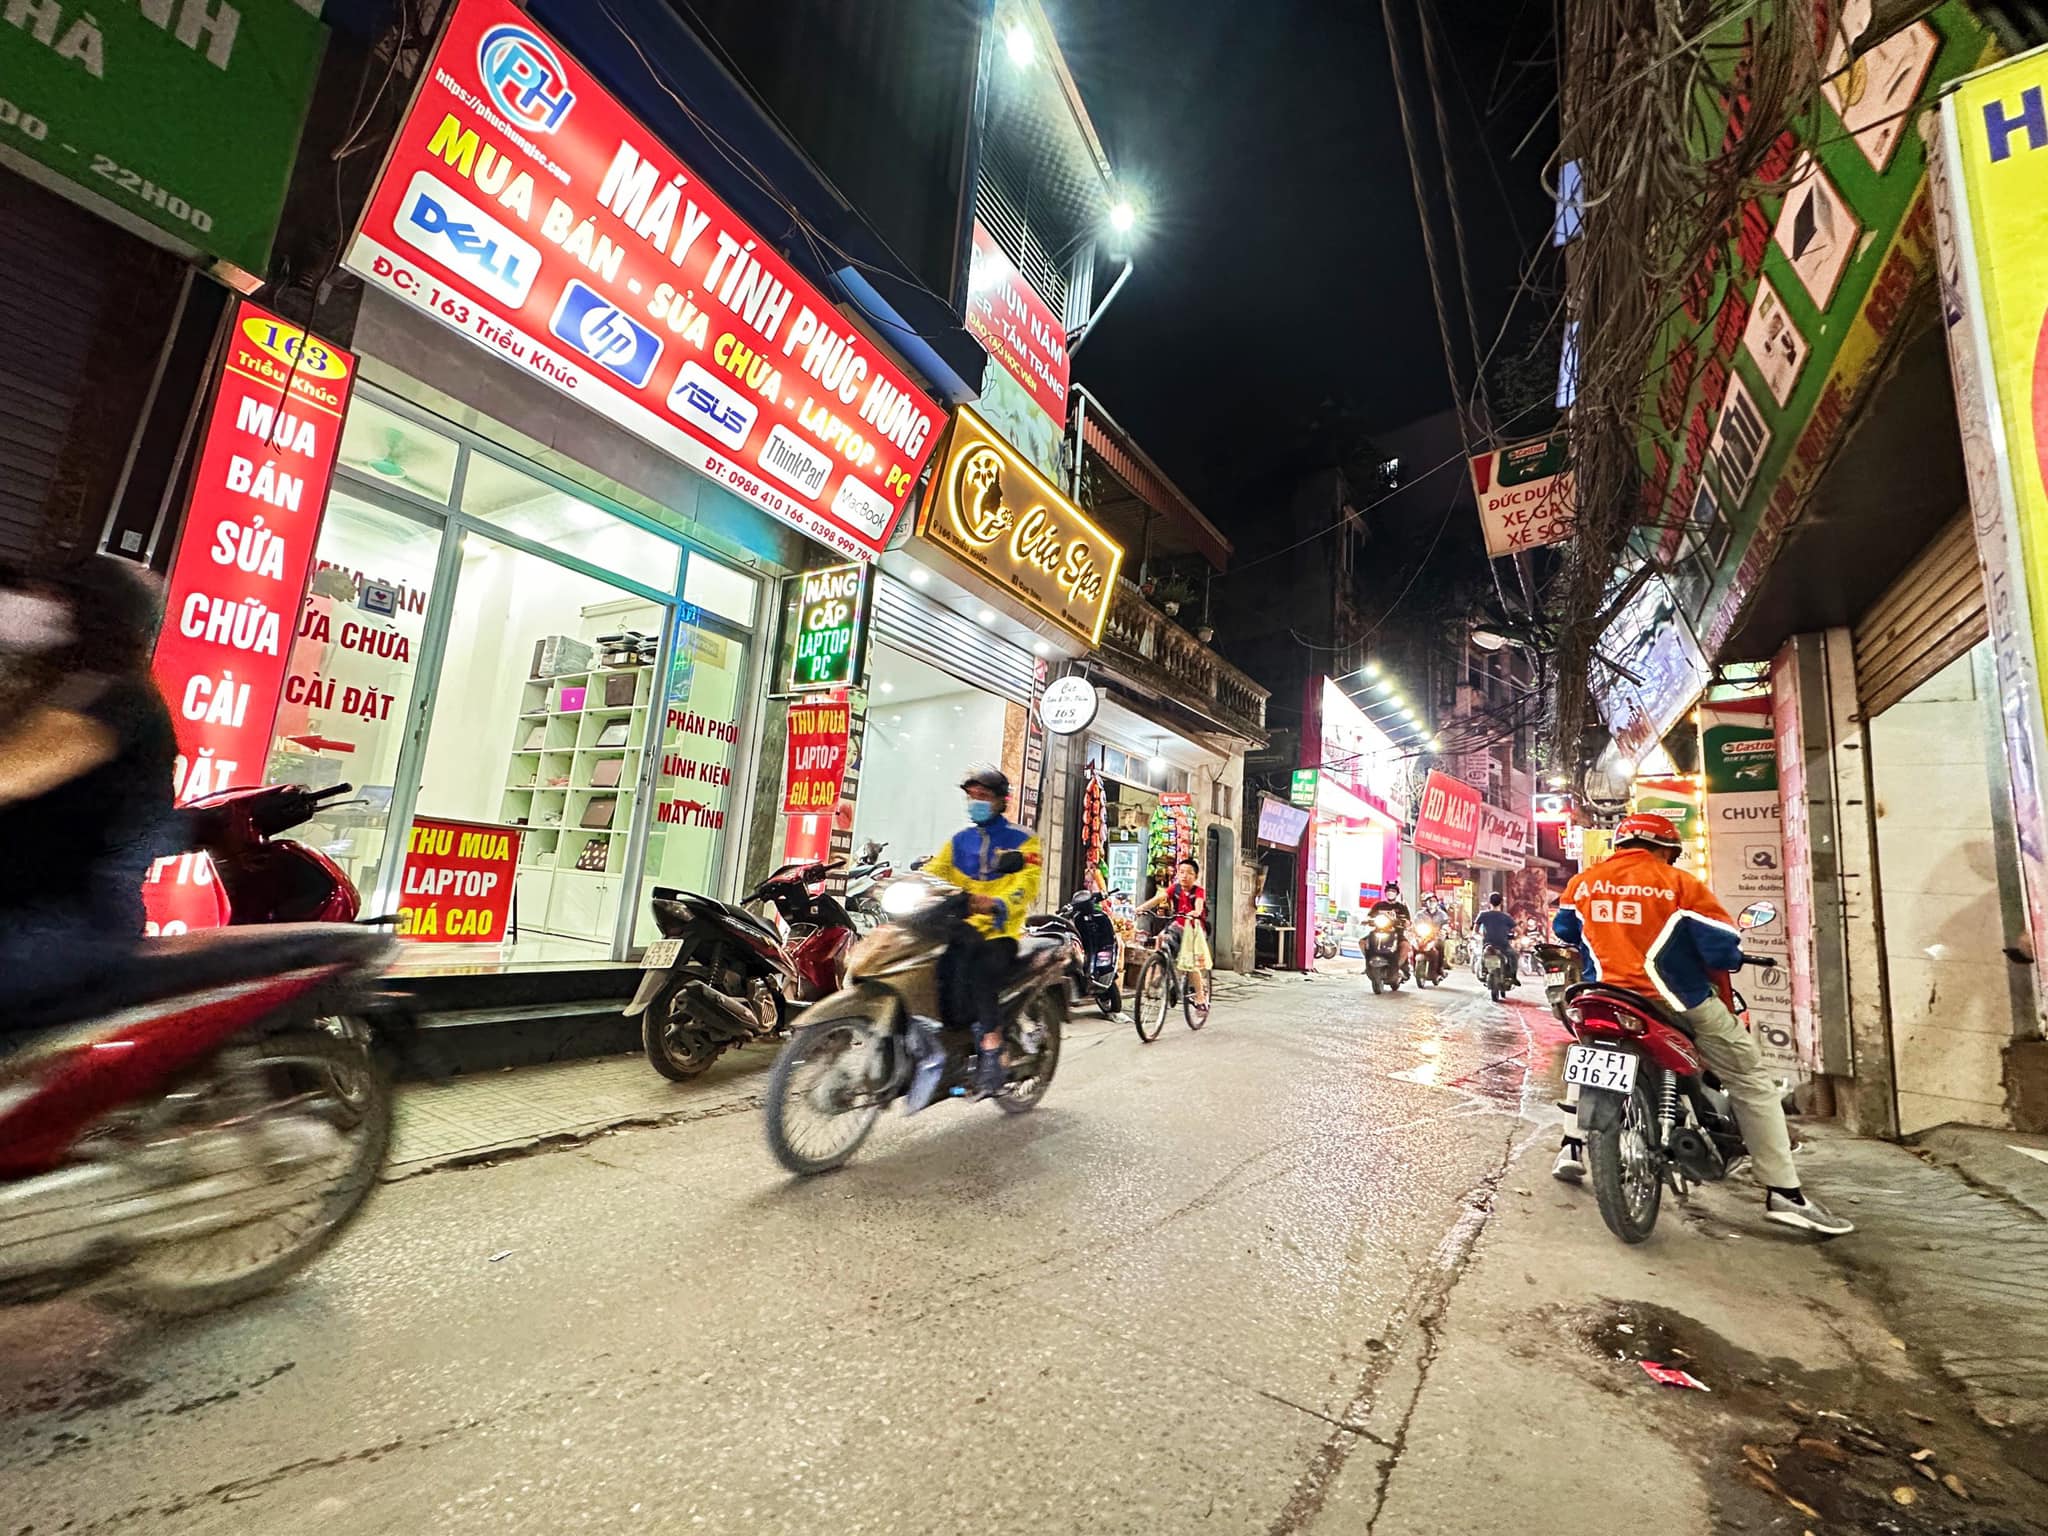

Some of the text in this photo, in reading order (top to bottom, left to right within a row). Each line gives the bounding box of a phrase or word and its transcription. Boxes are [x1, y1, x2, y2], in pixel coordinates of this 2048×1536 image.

[89, 153, 213, 233] 22H00
[409, 191, 521, 290] DELL
[426, 112, 536, 223] MUA
[539, 196, 627, 285] BÁN
[645, 281, 712, 352] SỬA
[796, 396, 878, 468] LAPTOP
[883, 463, 911, 500] PC
[596, 138, 932, 461] MÁY TÍNH PHÚC HƯNG
[372, 256, 579, 389] ĐC: 163 Triều Khúc
[585, 304, 634, 367] hp
[260, 324, 329, 372] 163
[1003, 349, 1021, 375] HỌC
[290, 372, 338, 406] Khúc
[675, 380, 748, 436] ASUS
[235, 395, 317, 459] MUA
[766, 433, 827, 491] ThinkPad
[225, 453, 304, 512] BÁN
[704, 456, 727, 478] ĐT:
[728, 471, 758, 496] 0988
[760, 491, 782, 510] 410
[785, 503, 804, 524] 166
[810, 520, 835, 542] 0398
[837, 536, 856, 554] 999
[840, 487, 887, 530] MacBook
[1487, 493, 1522, 512] ĐỨC
[1501, 501, 1563, 529] XE GA
[209, 515, 286, 582] SỬA
[1506, 528, 1536, 548] XE
[805, 573, 859, 603] NÂNG
[1060, 541, 1102, 602] Spa
[179, 592, 281, 657] CHỮA
[298, 597, 410, 664] ỬA CHỮA
[808, 600, 848, 632] CẤP
[798, 627, 850, 660] LAPTOP
[810, 656, 832, 682] PC
[181, 669, 252, 730] CÀI
[284, 671, 395, 723] CÀI ĐẶT
[666, 708, 740, 746] PHÂN PHỐI
[790, 709, 847, 736] THU MUA
[795, 745, 840, 771] LAPTOP
[1735, 740, 1777, 753] Castro
[698, 761, 732, 789] KIỆN
[789, 775, 836, 807] GIÁ CAO
[693, 800, 725, 831] TÍNH
[1423, 786, 1446, 823] HD
[1443, 793, 1477, 834] MART
[1721, 803, 1782, 821] CHUYÊ
[407, 826, 510, 862] THU MUA
[404, 866, 498, 898] LAPTOP
[1590, 879, 1677, 902] Ahamove
[396, 902, 493, 937] GIÁ CAO
[1747, 936, 1770, 947] Thay
